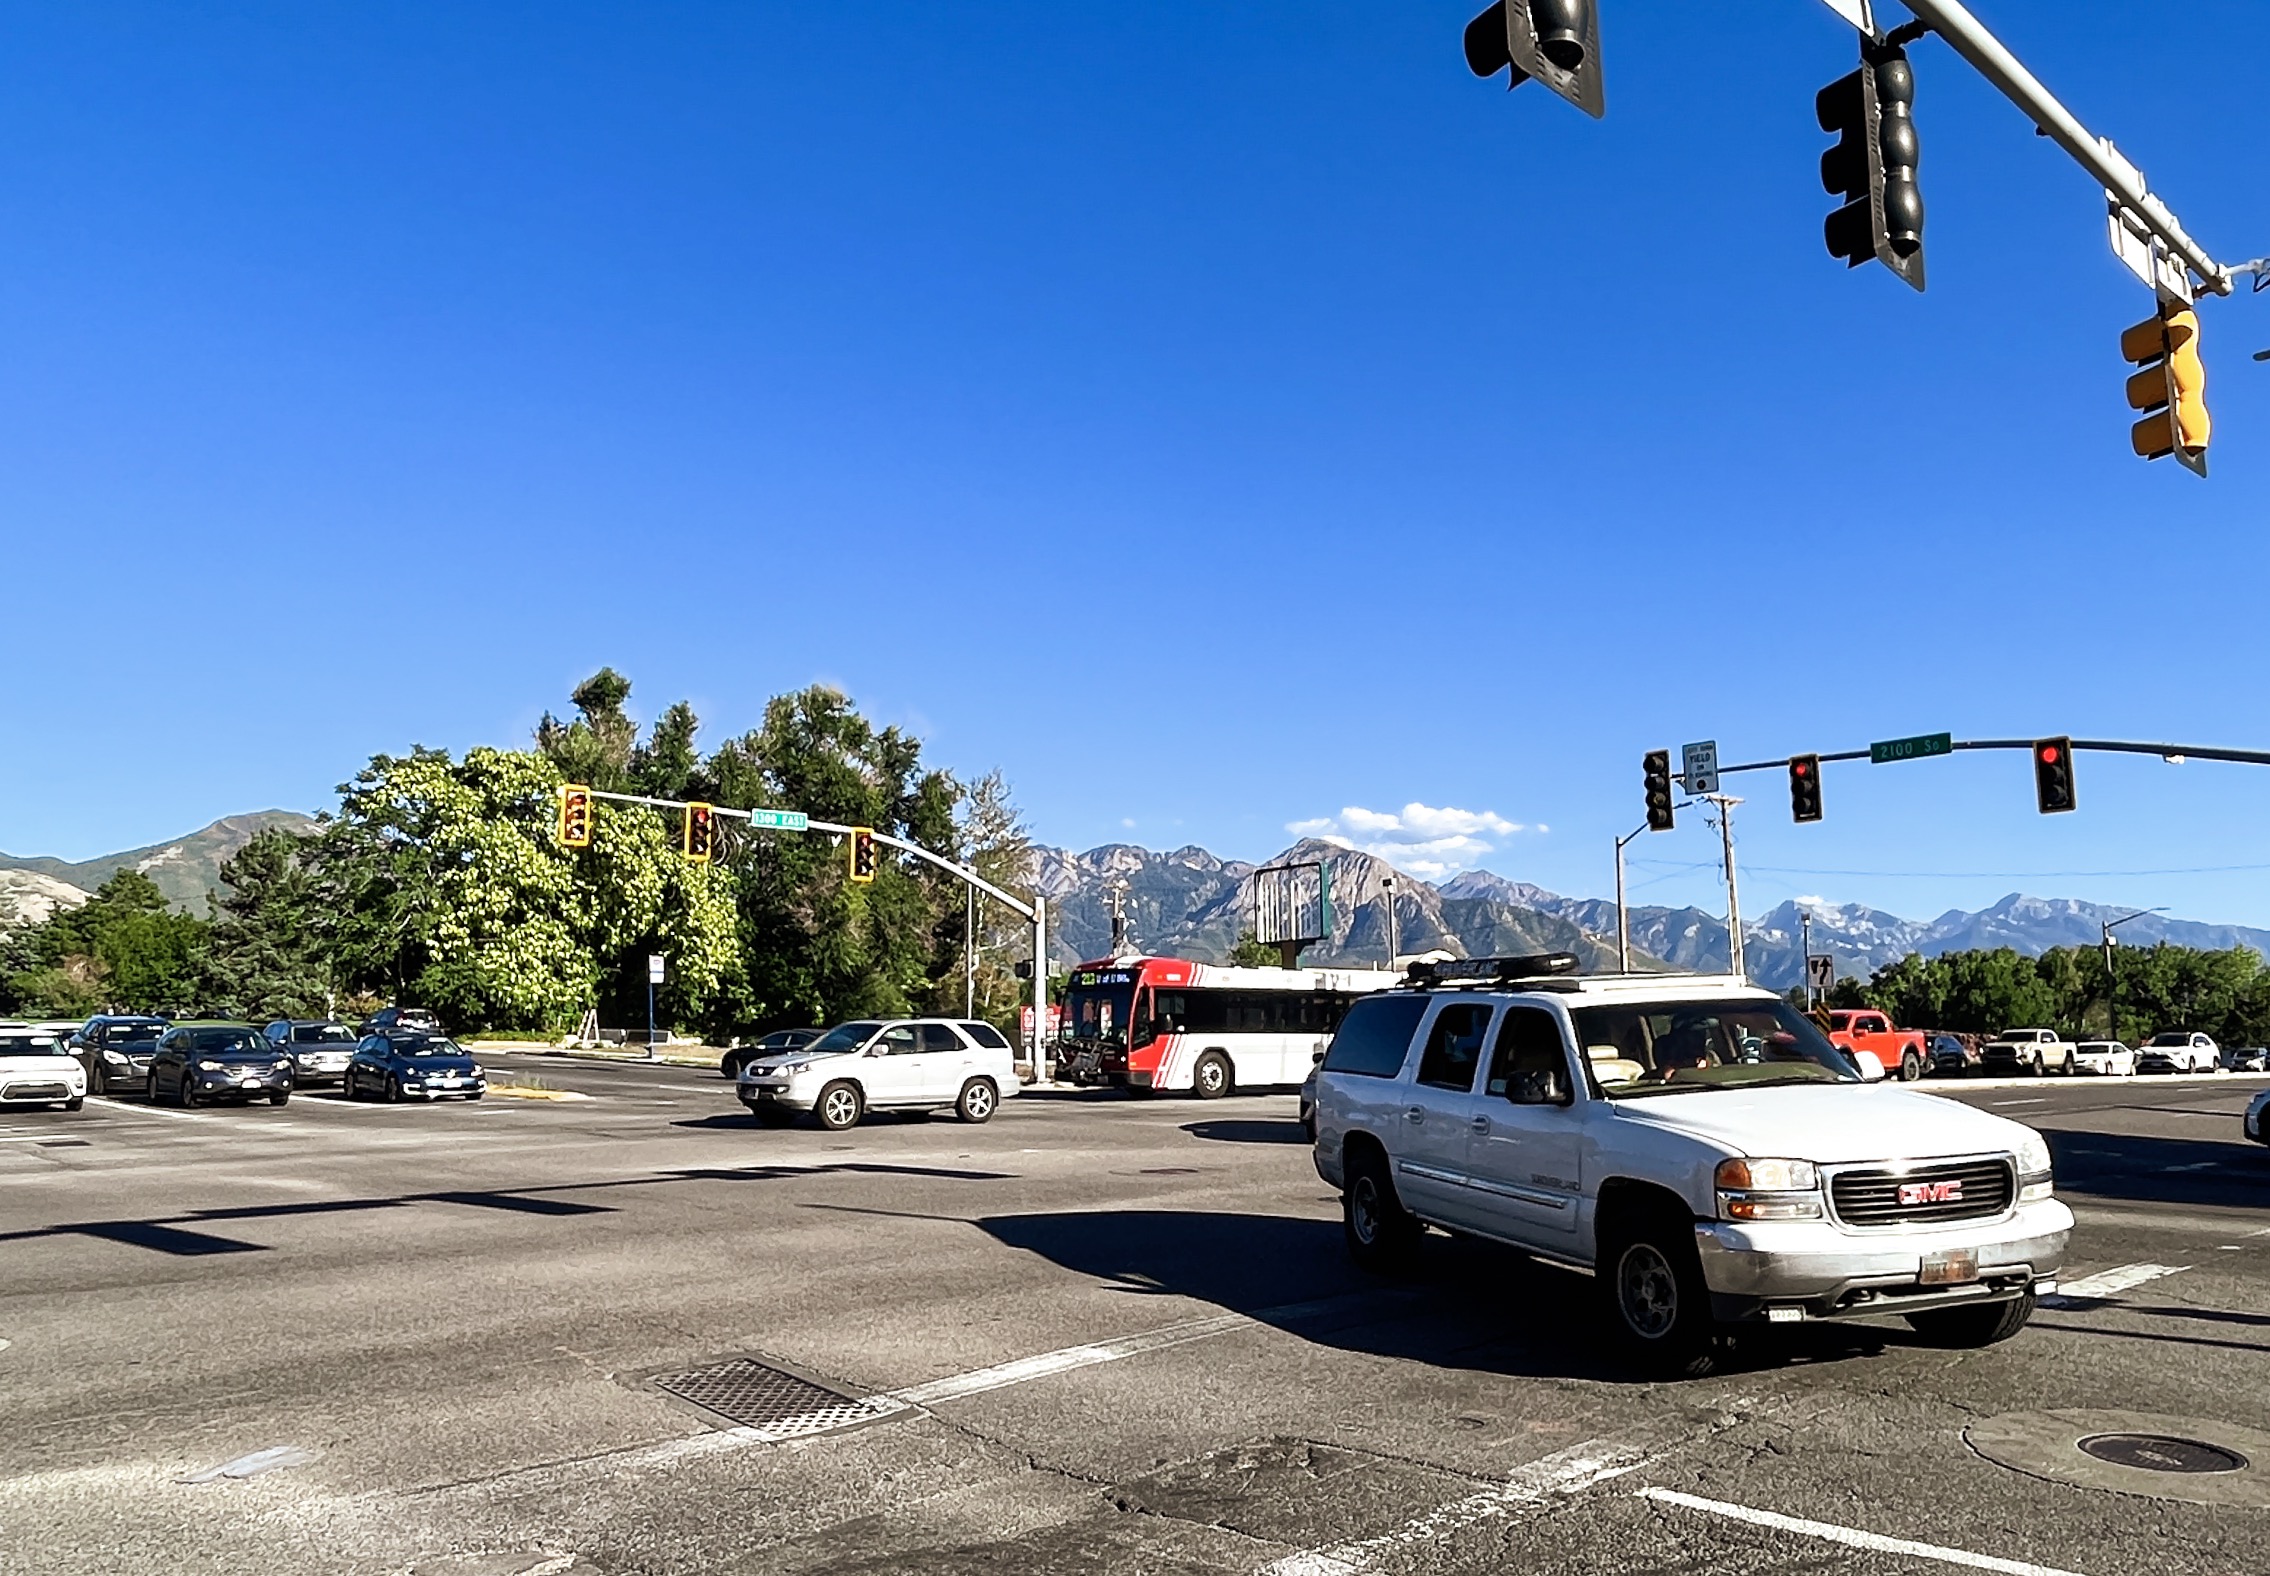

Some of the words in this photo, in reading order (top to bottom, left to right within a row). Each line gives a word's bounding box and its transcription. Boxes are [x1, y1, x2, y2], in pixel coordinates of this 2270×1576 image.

[1880, 742, 1913, 758] 2100
[1924, 739, 1940, 753] So
[1689, 752, 1711, 764] YIELD
[755, 812, 777, 824] 1300
[781, 813, 805, 827] EAST
[1898, 1180, 1963, 1204] GMC
